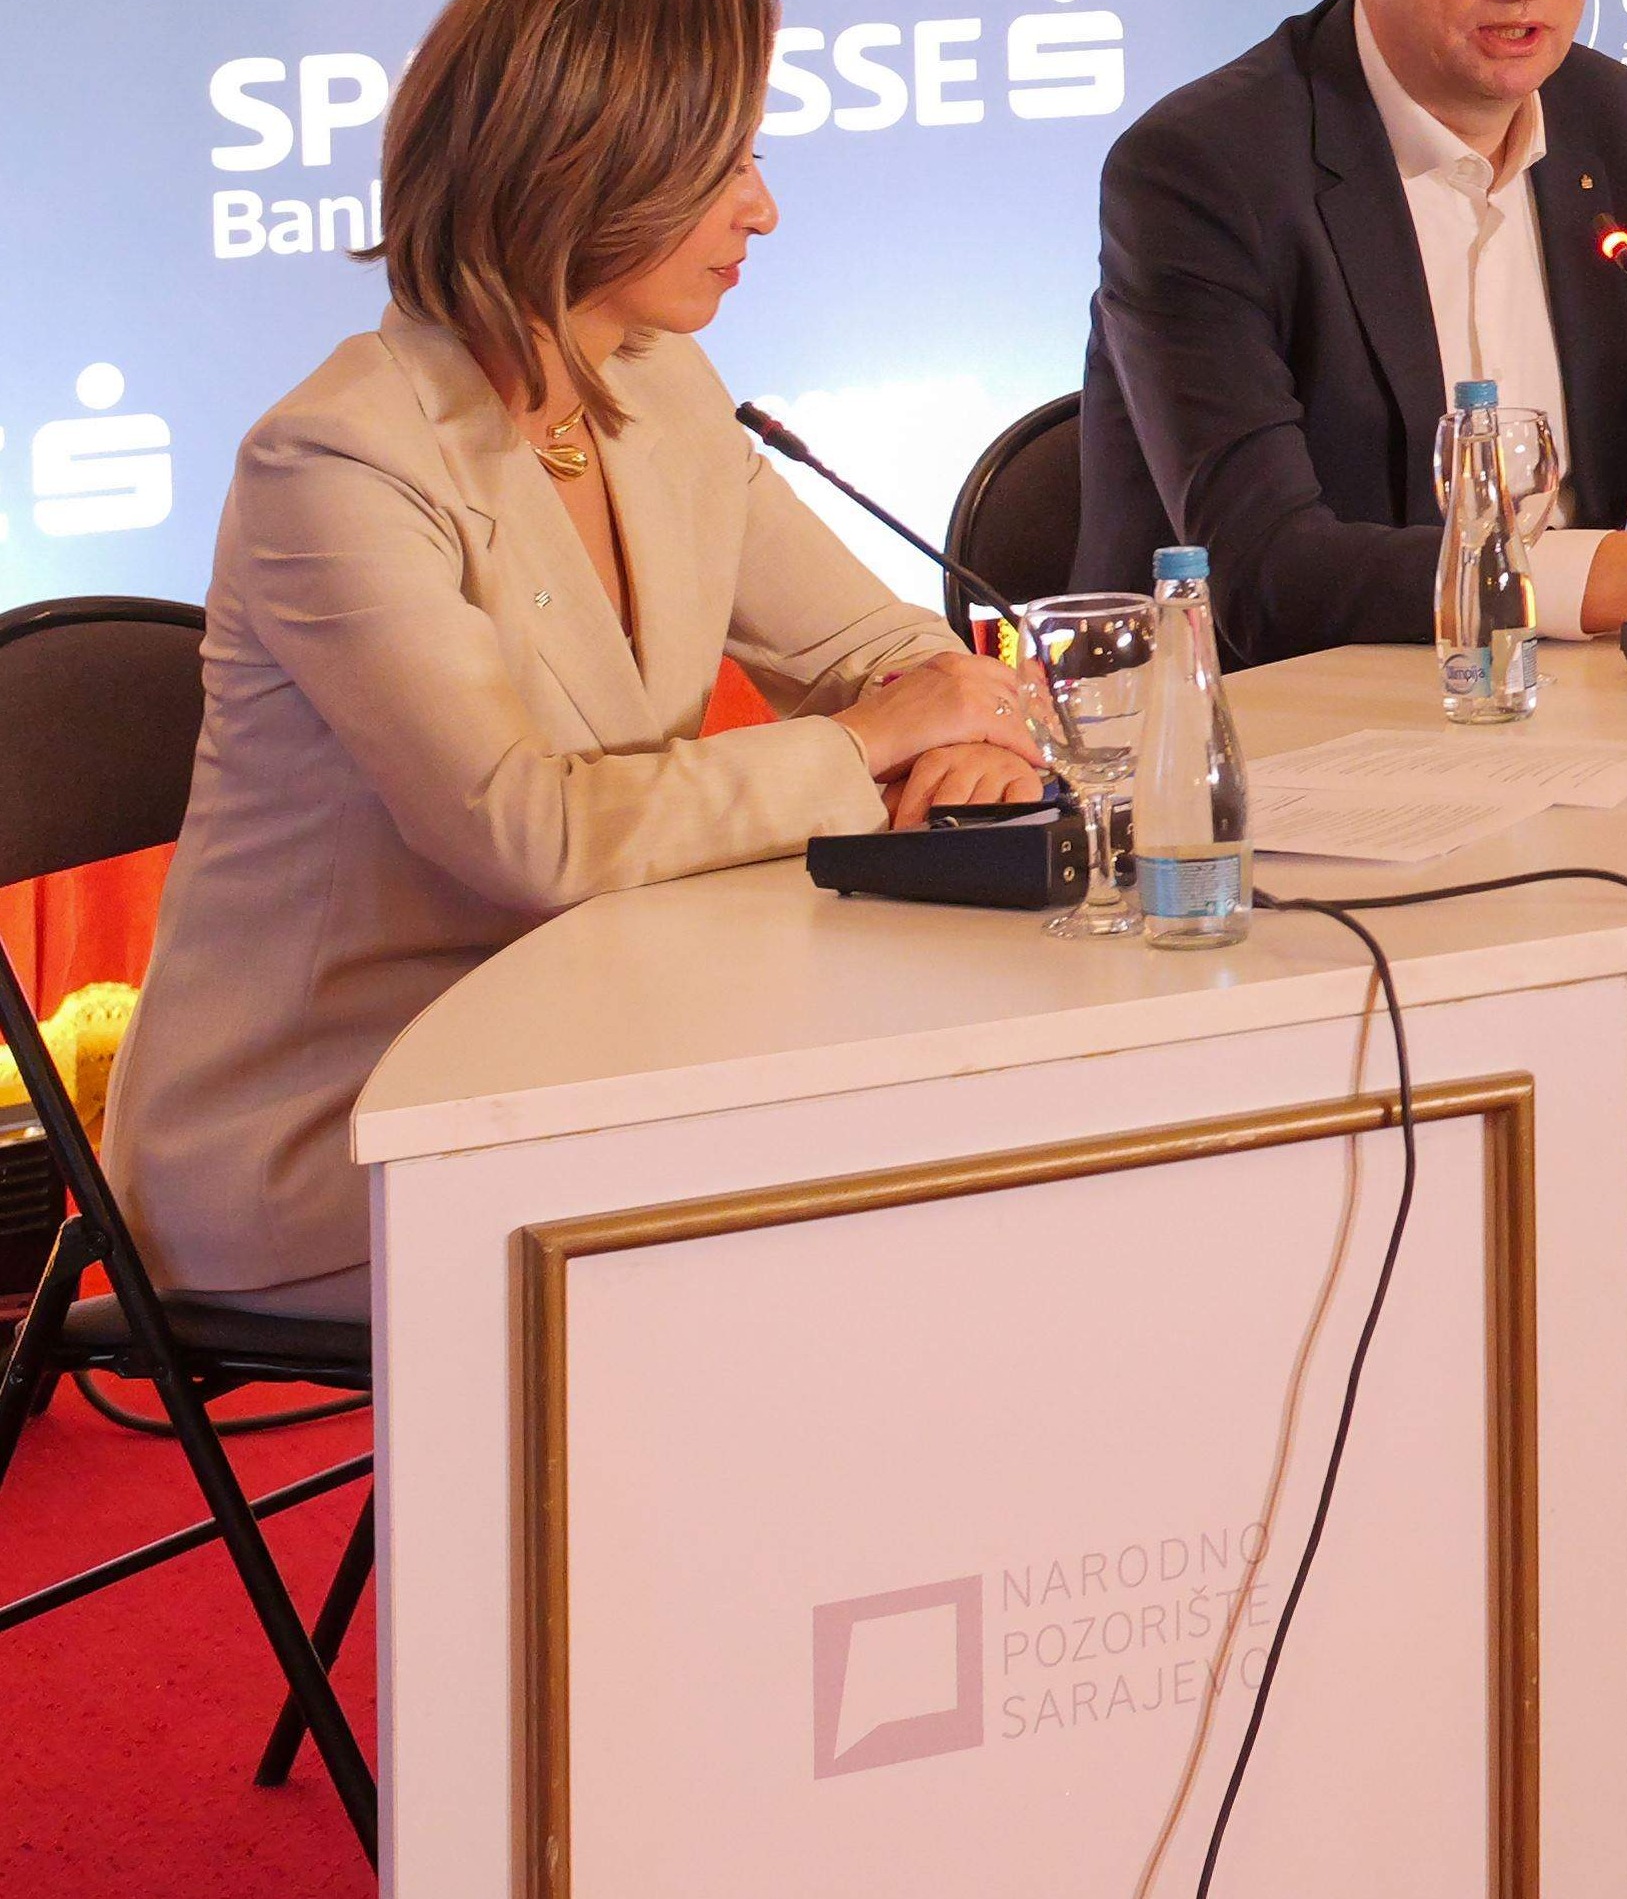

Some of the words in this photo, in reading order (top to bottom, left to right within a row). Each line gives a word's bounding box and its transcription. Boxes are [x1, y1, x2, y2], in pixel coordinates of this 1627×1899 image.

[209, 17, 986, 172] SPSSE
[212, 178, 384, 260] Ban
[1002, 1521, 1270, 1612] NARODNO
[1003, 1584, 1271, 1676] POZORIŠTE
[1001, 1647, 1270, 1739] SARAJEVO
